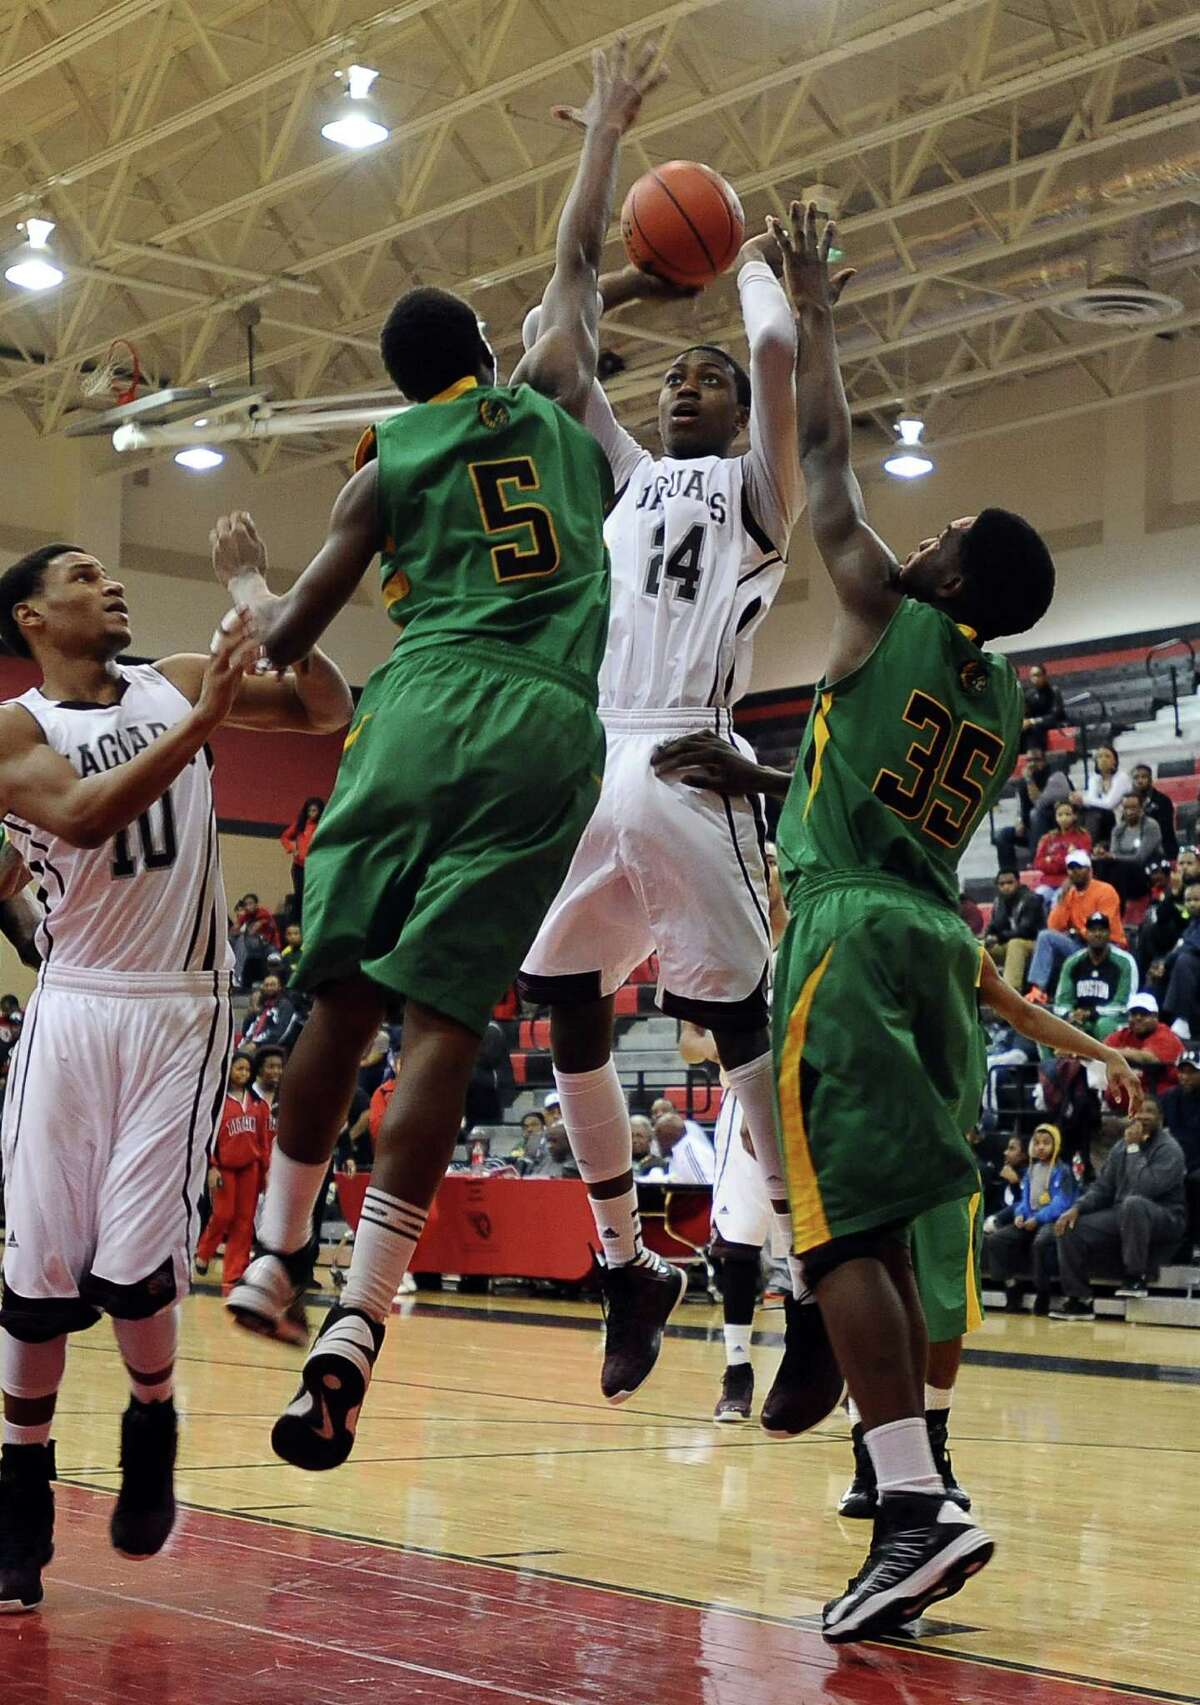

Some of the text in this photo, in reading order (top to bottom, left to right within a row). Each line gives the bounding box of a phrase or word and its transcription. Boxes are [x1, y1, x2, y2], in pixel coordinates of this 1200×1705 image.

[468, 455, 561, 583] 5
[641, 520, 708, 606] 24
[871, 688, 1006, 849] 35
